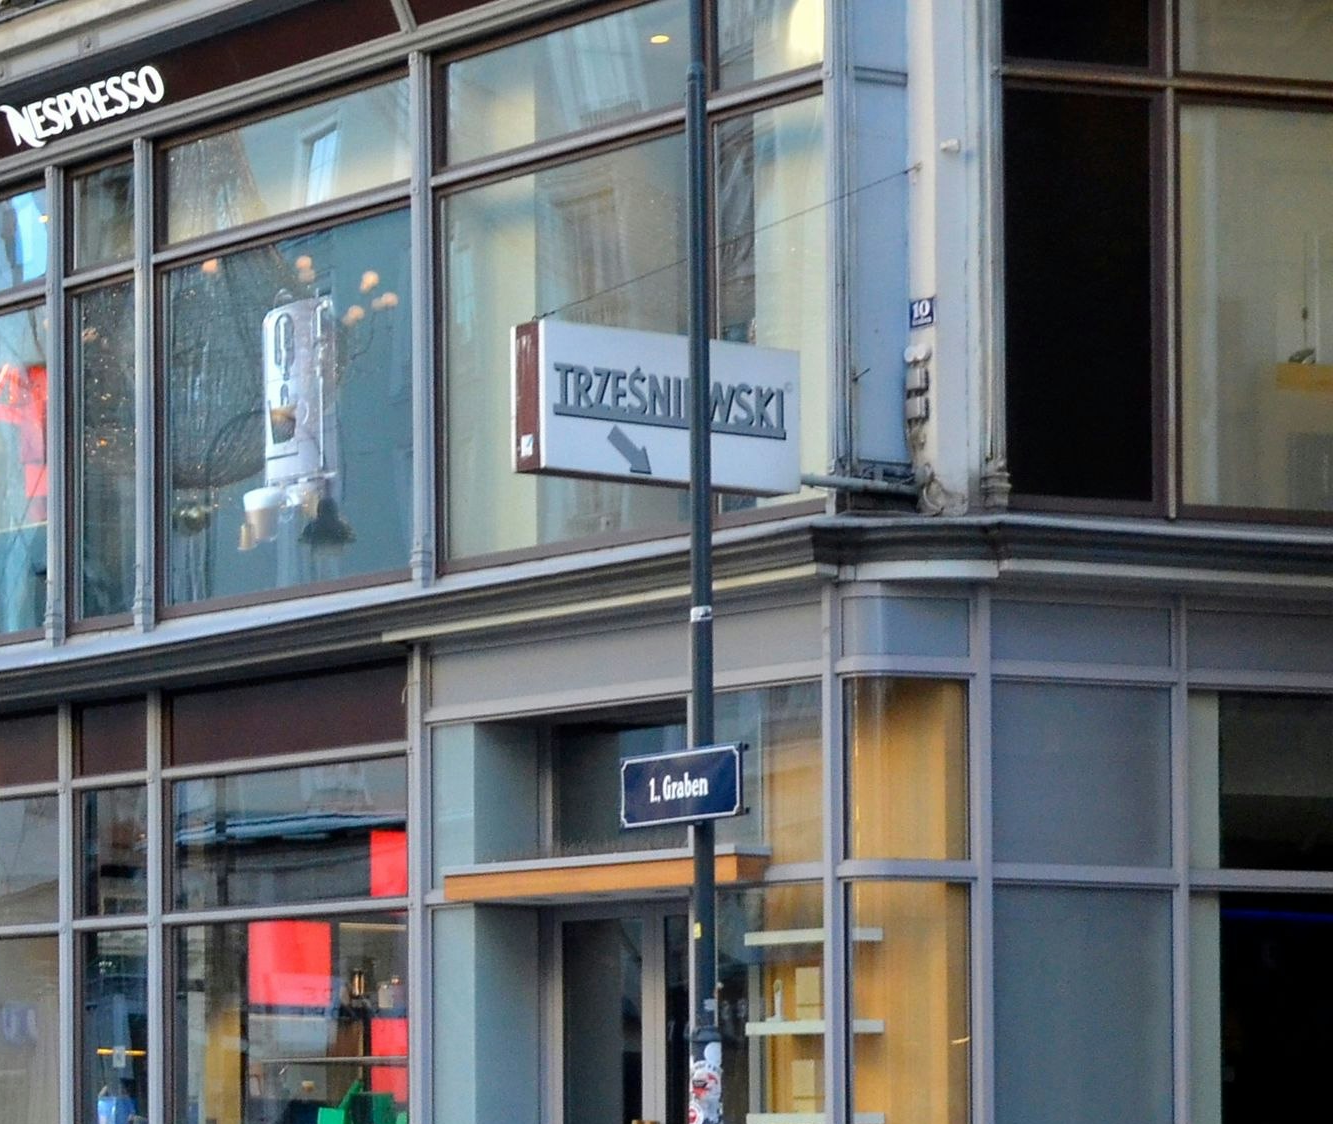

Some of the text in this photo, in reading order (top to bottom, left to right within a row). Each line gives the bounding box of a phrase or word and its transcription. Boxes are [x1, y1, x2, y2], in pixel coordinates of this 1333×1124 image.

[913, 299, 930, 318] 10
[553, 361, 787, 432] TRZEŚNIWSKI
[662, 771, 709, 802] Graben
